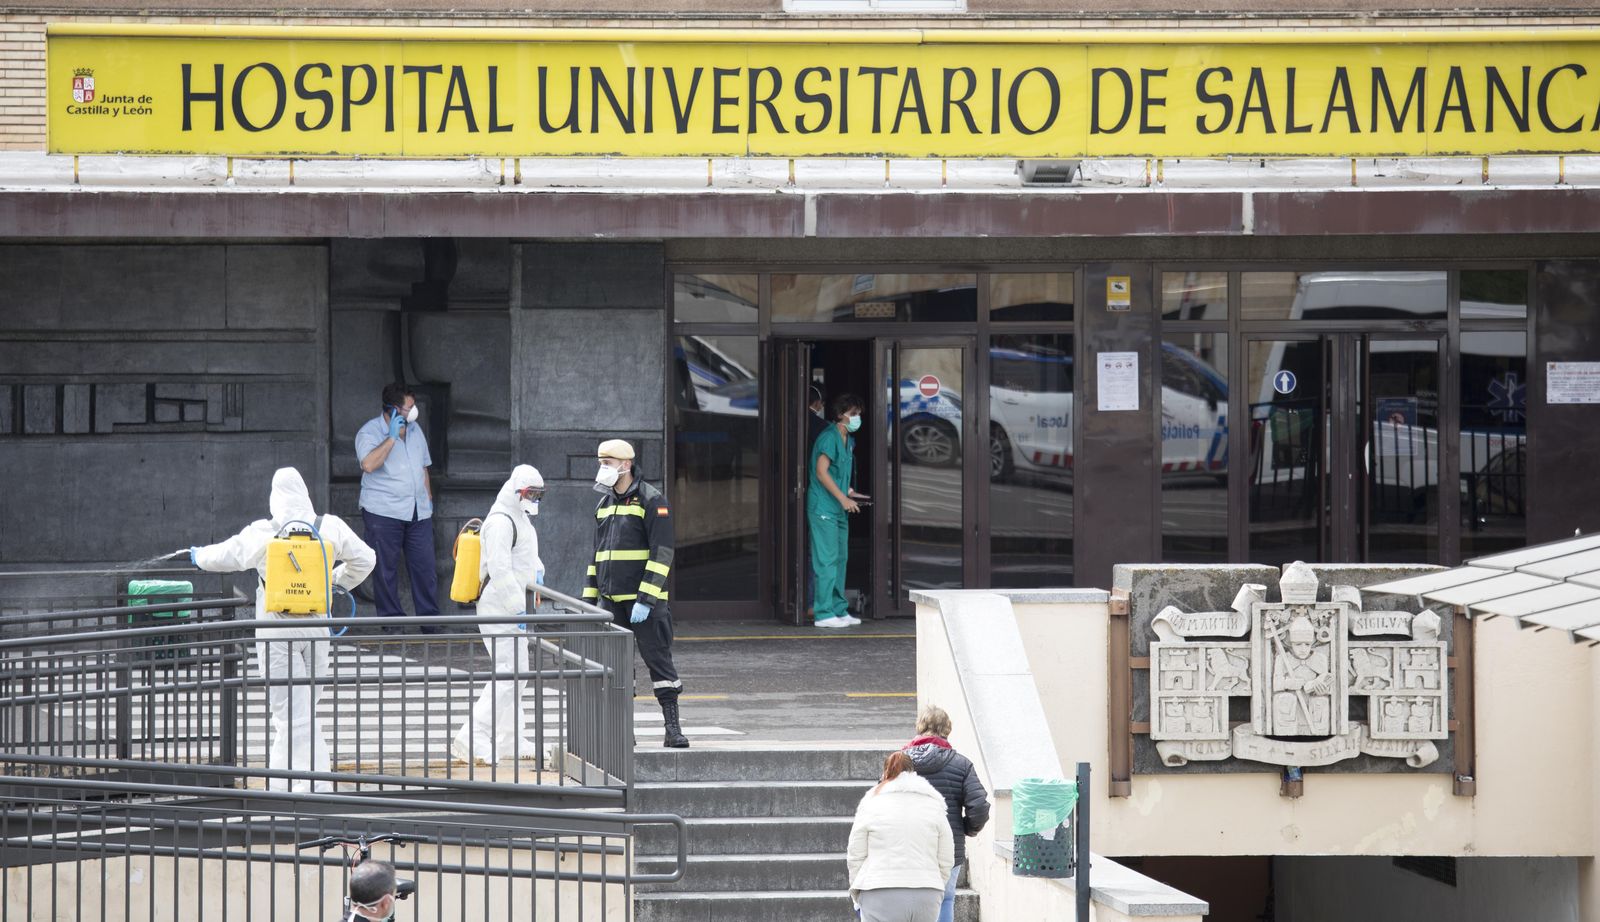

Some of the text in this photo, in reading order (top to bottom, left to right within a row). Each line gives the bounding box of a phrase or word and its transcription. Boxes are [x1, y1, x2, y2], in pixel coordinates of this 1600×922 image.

[100, 94, 153, 104] Junta de
[181, 62, 1600, 135] HOSPITAL UNIVERSITARIO DE SALAMANC
[66, 104, 153, 118] Castilla y León
